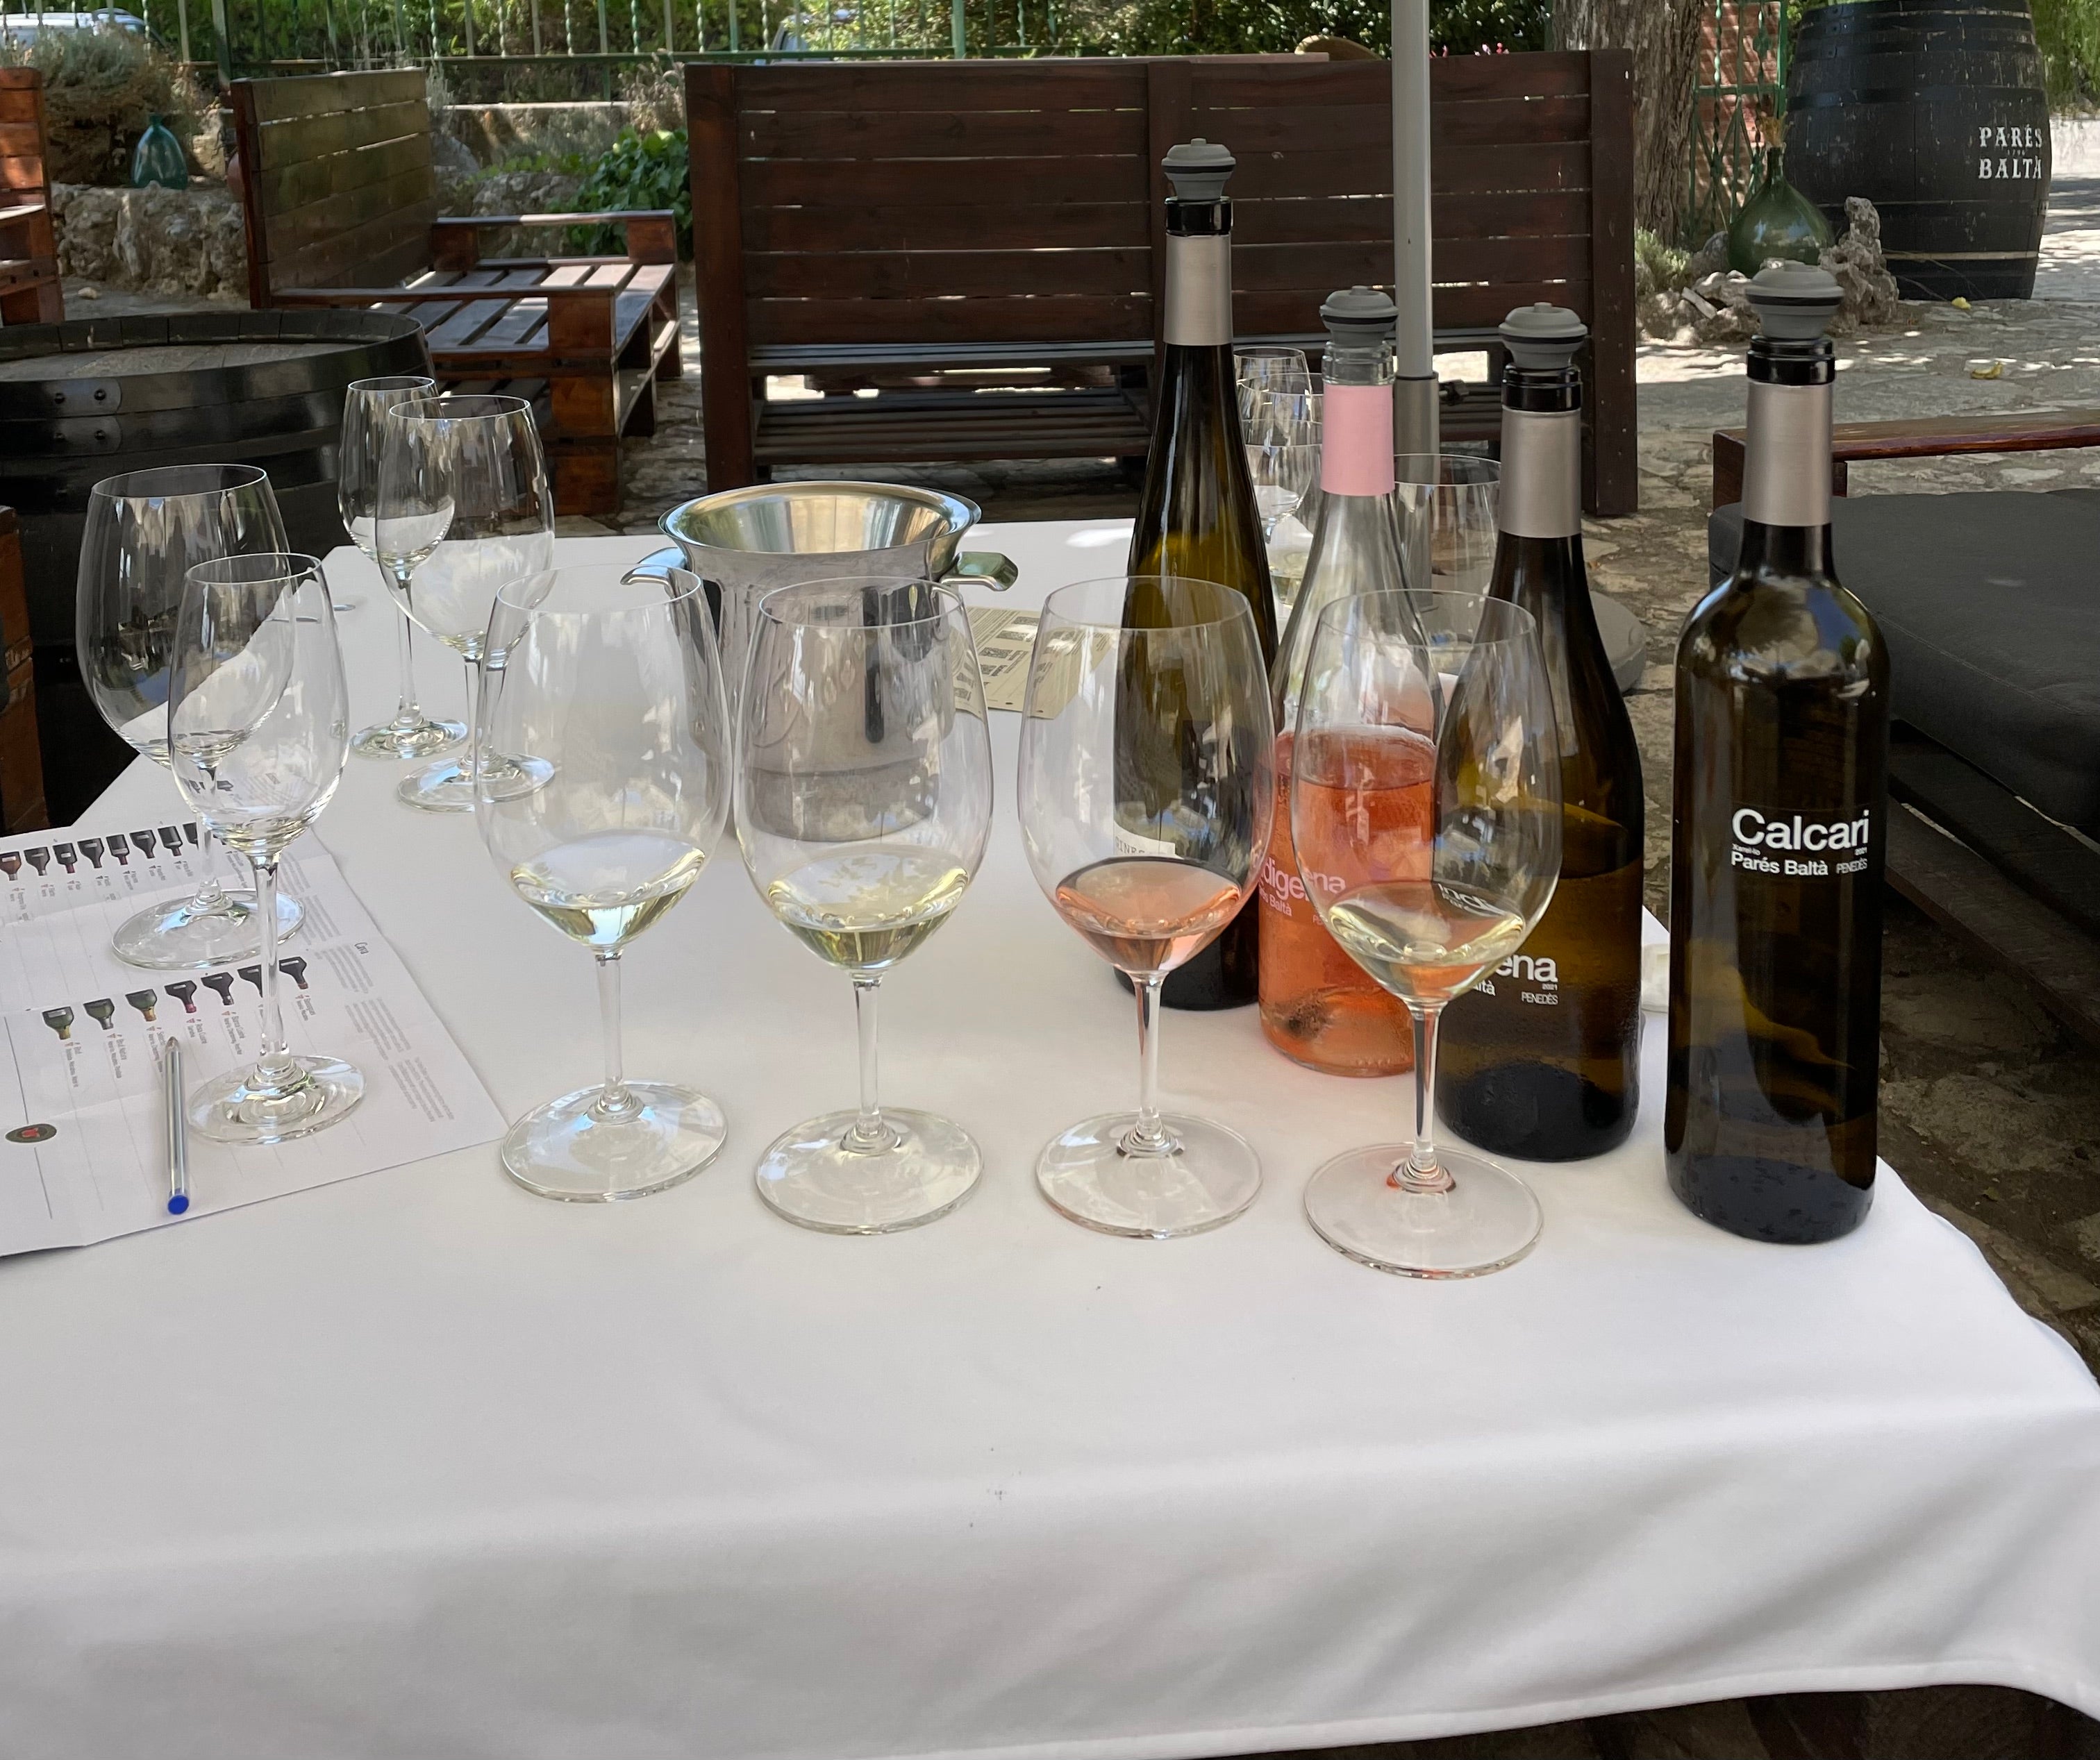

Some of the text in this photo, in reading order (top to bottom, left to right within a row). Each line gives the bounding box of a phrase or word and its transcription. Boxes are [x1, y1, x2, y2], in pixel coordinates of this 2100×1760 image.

[1978, 124, 2042, 148] PARÉS
[1732, 808, 1869, 851] Calcari
[1731, 850, 1781, 874] Parés
[1784, 859, 1828, 876] Baltà
[1269, 894, 1292, 917] Baltà
[1522, 991, 1558, 1005] PENEDÈS
